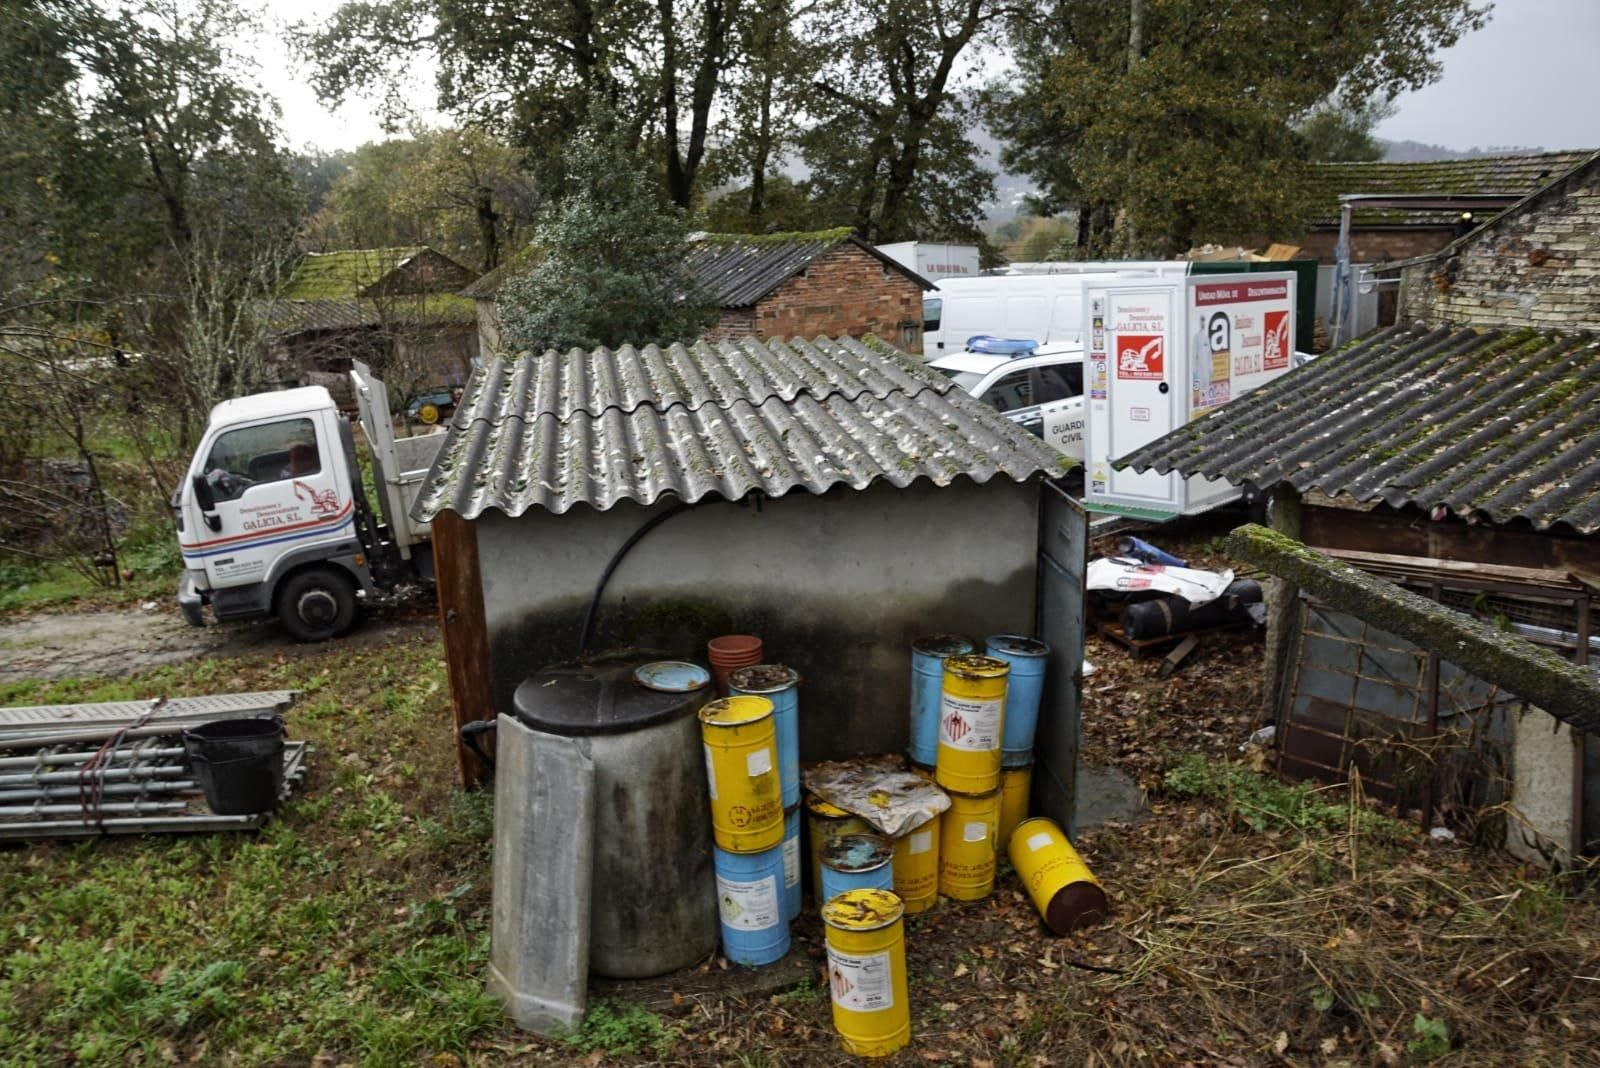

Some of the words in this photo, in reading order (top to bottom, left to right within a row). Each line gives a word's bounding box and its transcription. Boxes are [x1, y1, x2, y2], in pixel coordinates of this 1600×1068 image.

[1210, 317, 1229, 352] a
[1052, 419, 1085, 435] GUARDI
[1061, 432, 1083, 444] CIVIL
